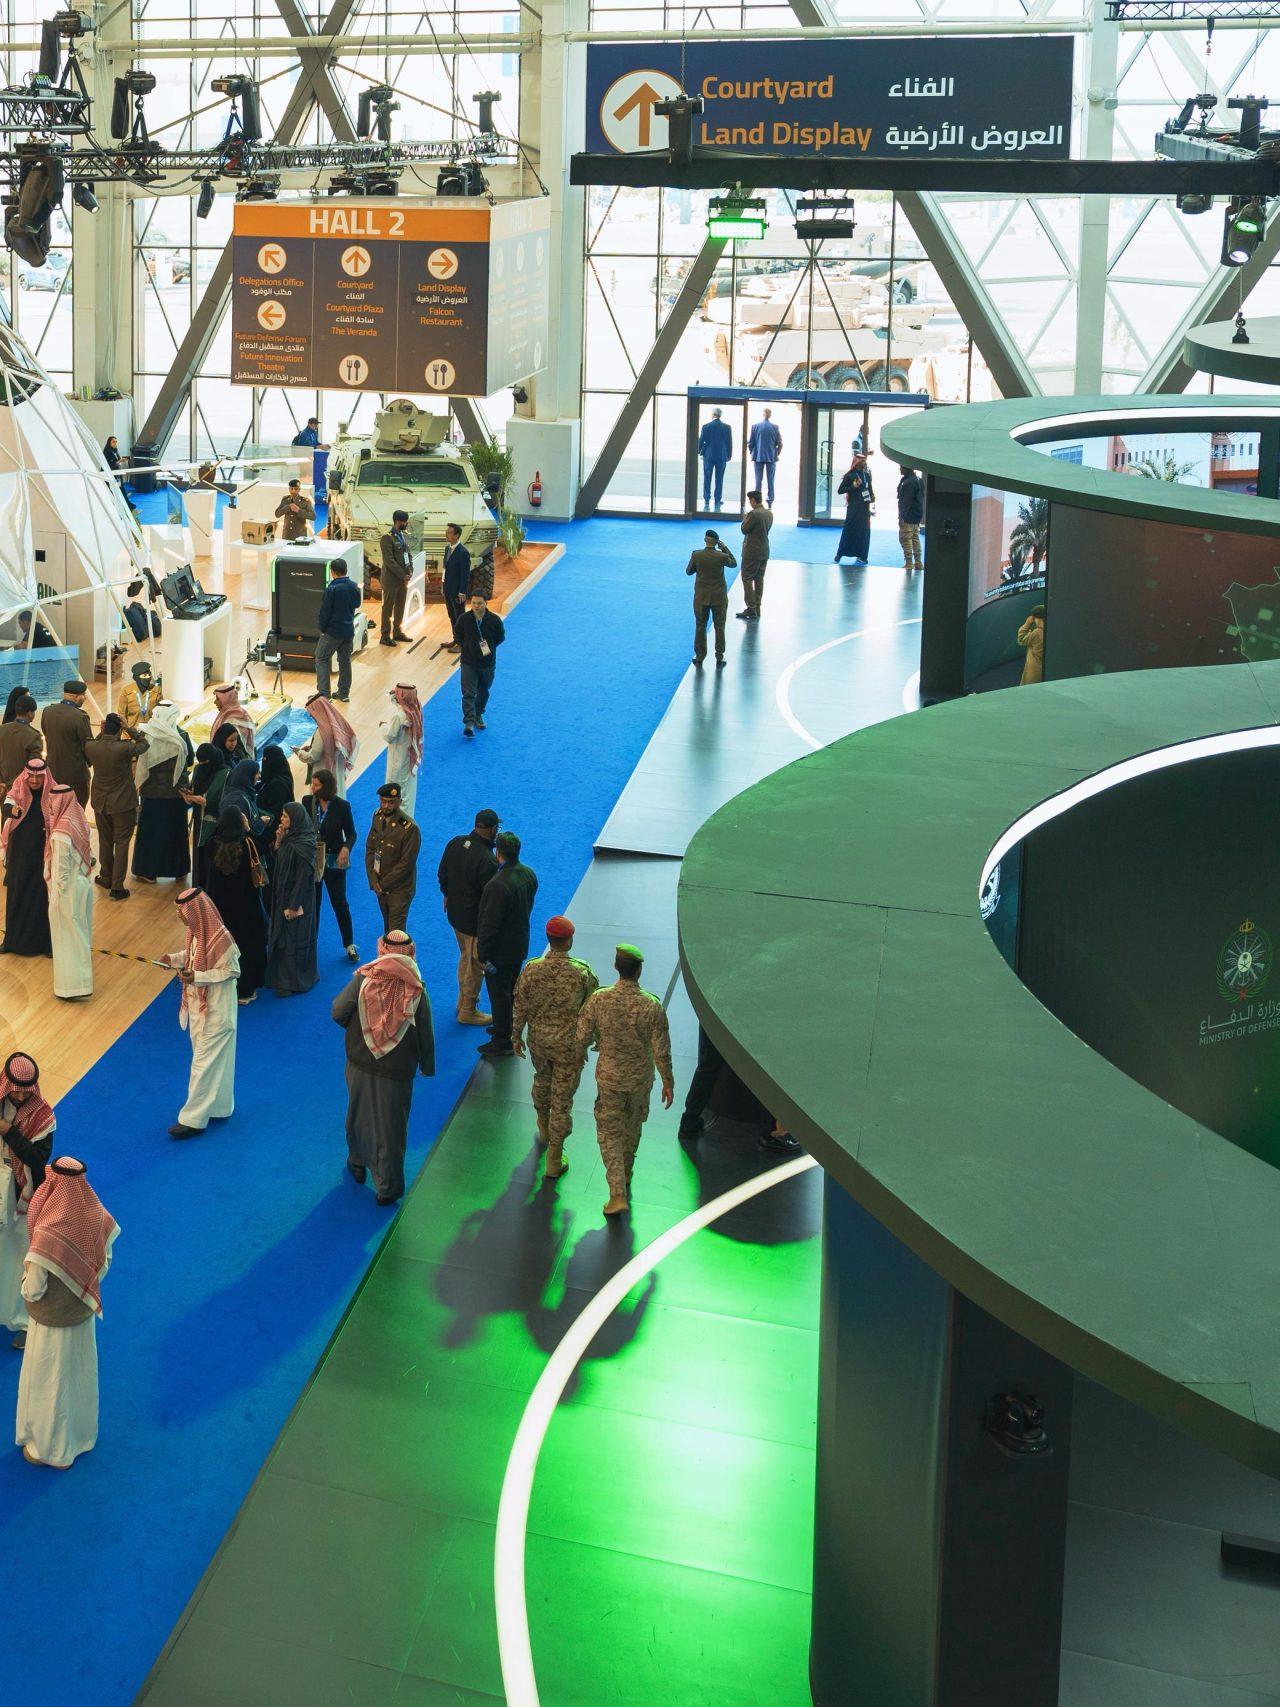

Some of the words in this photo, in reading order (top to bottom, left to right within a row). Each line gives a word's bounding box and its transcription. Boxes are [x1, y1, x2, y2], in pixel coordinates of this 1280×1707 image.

[702, 75, 834, 105] Courtyard
[888, 77, 954, 97] الفناء
[701, 122, 764, 145] Land
[773, 121, 872, 151] Display
[885, 121, 964, 151] الأرضية
[971, 125, 1063, 151] العروض
[310, 209, 381, 235] HALL
[388, 211, 405, 236] 2
[240, 276, 281, 287] Delegations
[282, 278, 305, 287] Office
[337, 280, 374, 291] Courtyard
[251, 288, 272, 296] الوفود
[274, 288, 292, 296] مكتب
[418, 284, 437, 292] Land
[438, 284, 467, 294] Display
[416, 294, 440, 304] الأرضية
[441, 296, 468, 305] العروض
[326, 303, 362, 314] Courtyard
[363, 305, 384, 313] Plaza
[429, 307, 455, 316] Falcon
[355, 316, 374, 324] ساحة
[420, 316, 464, 326] Restaurant
[331, 326, 346, 335] The
[347, 327, 378, 337] Veranda
[235, 333, 256, 341] Future
[285, 335, 307, 343] Forum
[239, 342, 258, 351] الدفاع
[240, 352, 264, 361] Future
[265, 353, 303, 363] Innovation
[258, 363, 286, 371] Theatre
[234, 371, 264, 380] المستقبل
[1200, 1004, 1253, 1035] الدفاع
[1199, 1028, 1236, 1046] MINISTRY
[1236, 1026, 1248, 1037] OF
[1248, 1017, 1280, 1034] DEFENSE
